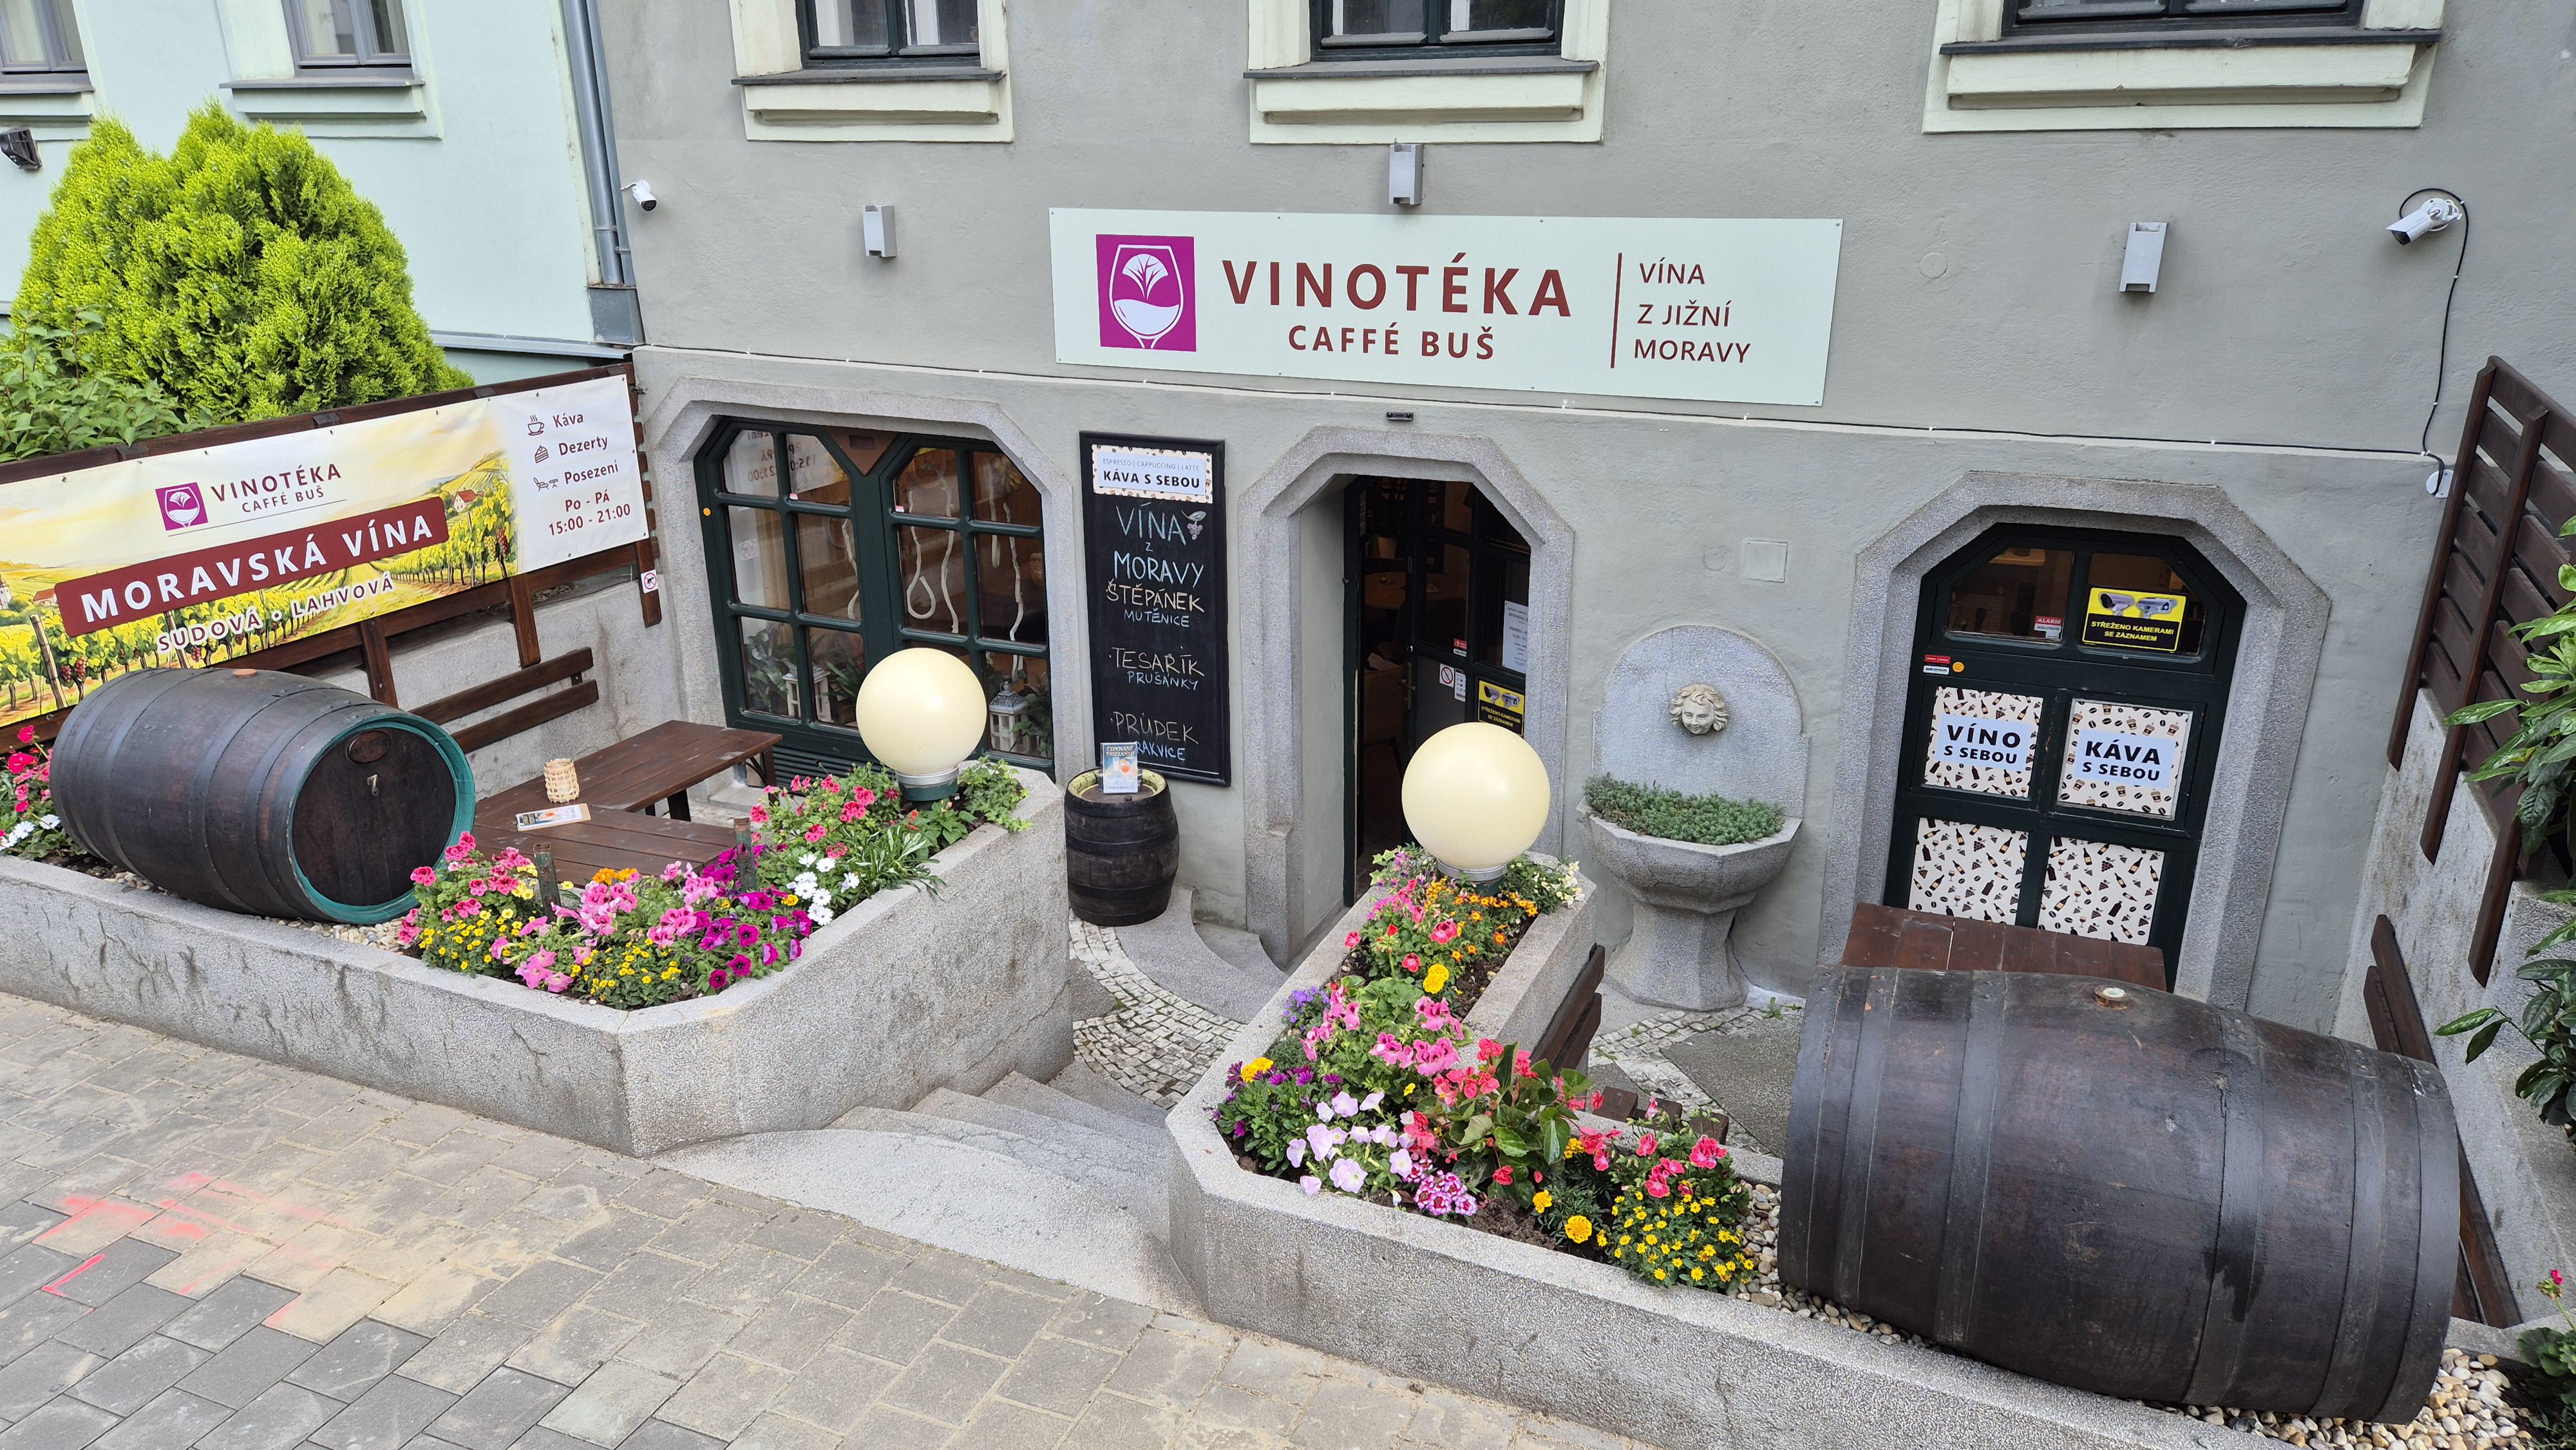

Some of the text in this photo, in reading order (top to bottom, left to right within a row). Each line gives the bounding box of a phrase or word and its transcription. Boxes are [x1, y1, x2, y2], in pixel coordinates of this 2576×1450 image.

[1639, 256, 1705, 285] VÍNA
[1221, 252, 1571, 317] VINOTÉKA
[1637, 299, 1732, 327] Z JIŽNÍ
[1288, 321, 1494, 360] CAFFÉ BUŠ
[1634, 339, 1752, 363] MORAVY
[553, 412, 584, 428] Káva
[558, 435, 609, 456] Dezerty
[564, 459, 619, 484] Posezení
[1103, 458, 1132, 467] ESPRESSO
[1137, 460, 1176, 470] CAPPUCCINO
[1181, 464, 1200, 472] LATTE
[1103, 468, 1200, 489] KÁVA S SEBOU
[211, 463, 342, 502] VINOTÉKA
[242, 485, 325, 513] CAFFÉ BUŠ
[565, 498, 582, 513] Po
[595, 489, 611, 505] PÁ
[549, 516, 584, 536] 15:00
[597, 504, 631, 523] 21:00
[1115, 502, 1187, 546] VÍNA
[80, 514, 433, 623] MORAVSKÁ VÍNA
[1113, 550, 1204, 588] MORAVY
[1106, 578, 1205, 614] ŠTĚPÁNEK
[157, 572, 395, 652] SUDOVÁ LAHVOVÁ
[1123, 607, 1190, 628] MUTĚNICE
[2090, 621, 2174, 635] STŘEŽENO KAMERAMI
[2115, 631, 2158, 643] ZÁZNAMEM
[1947, 722, 2021, 749] VÍNO
[1944, 745, 2018, 764] S SEBOU
[2085, 739, 2161, 766] KÁVA
[2082, 761, 2161, 781] S SEBOU
